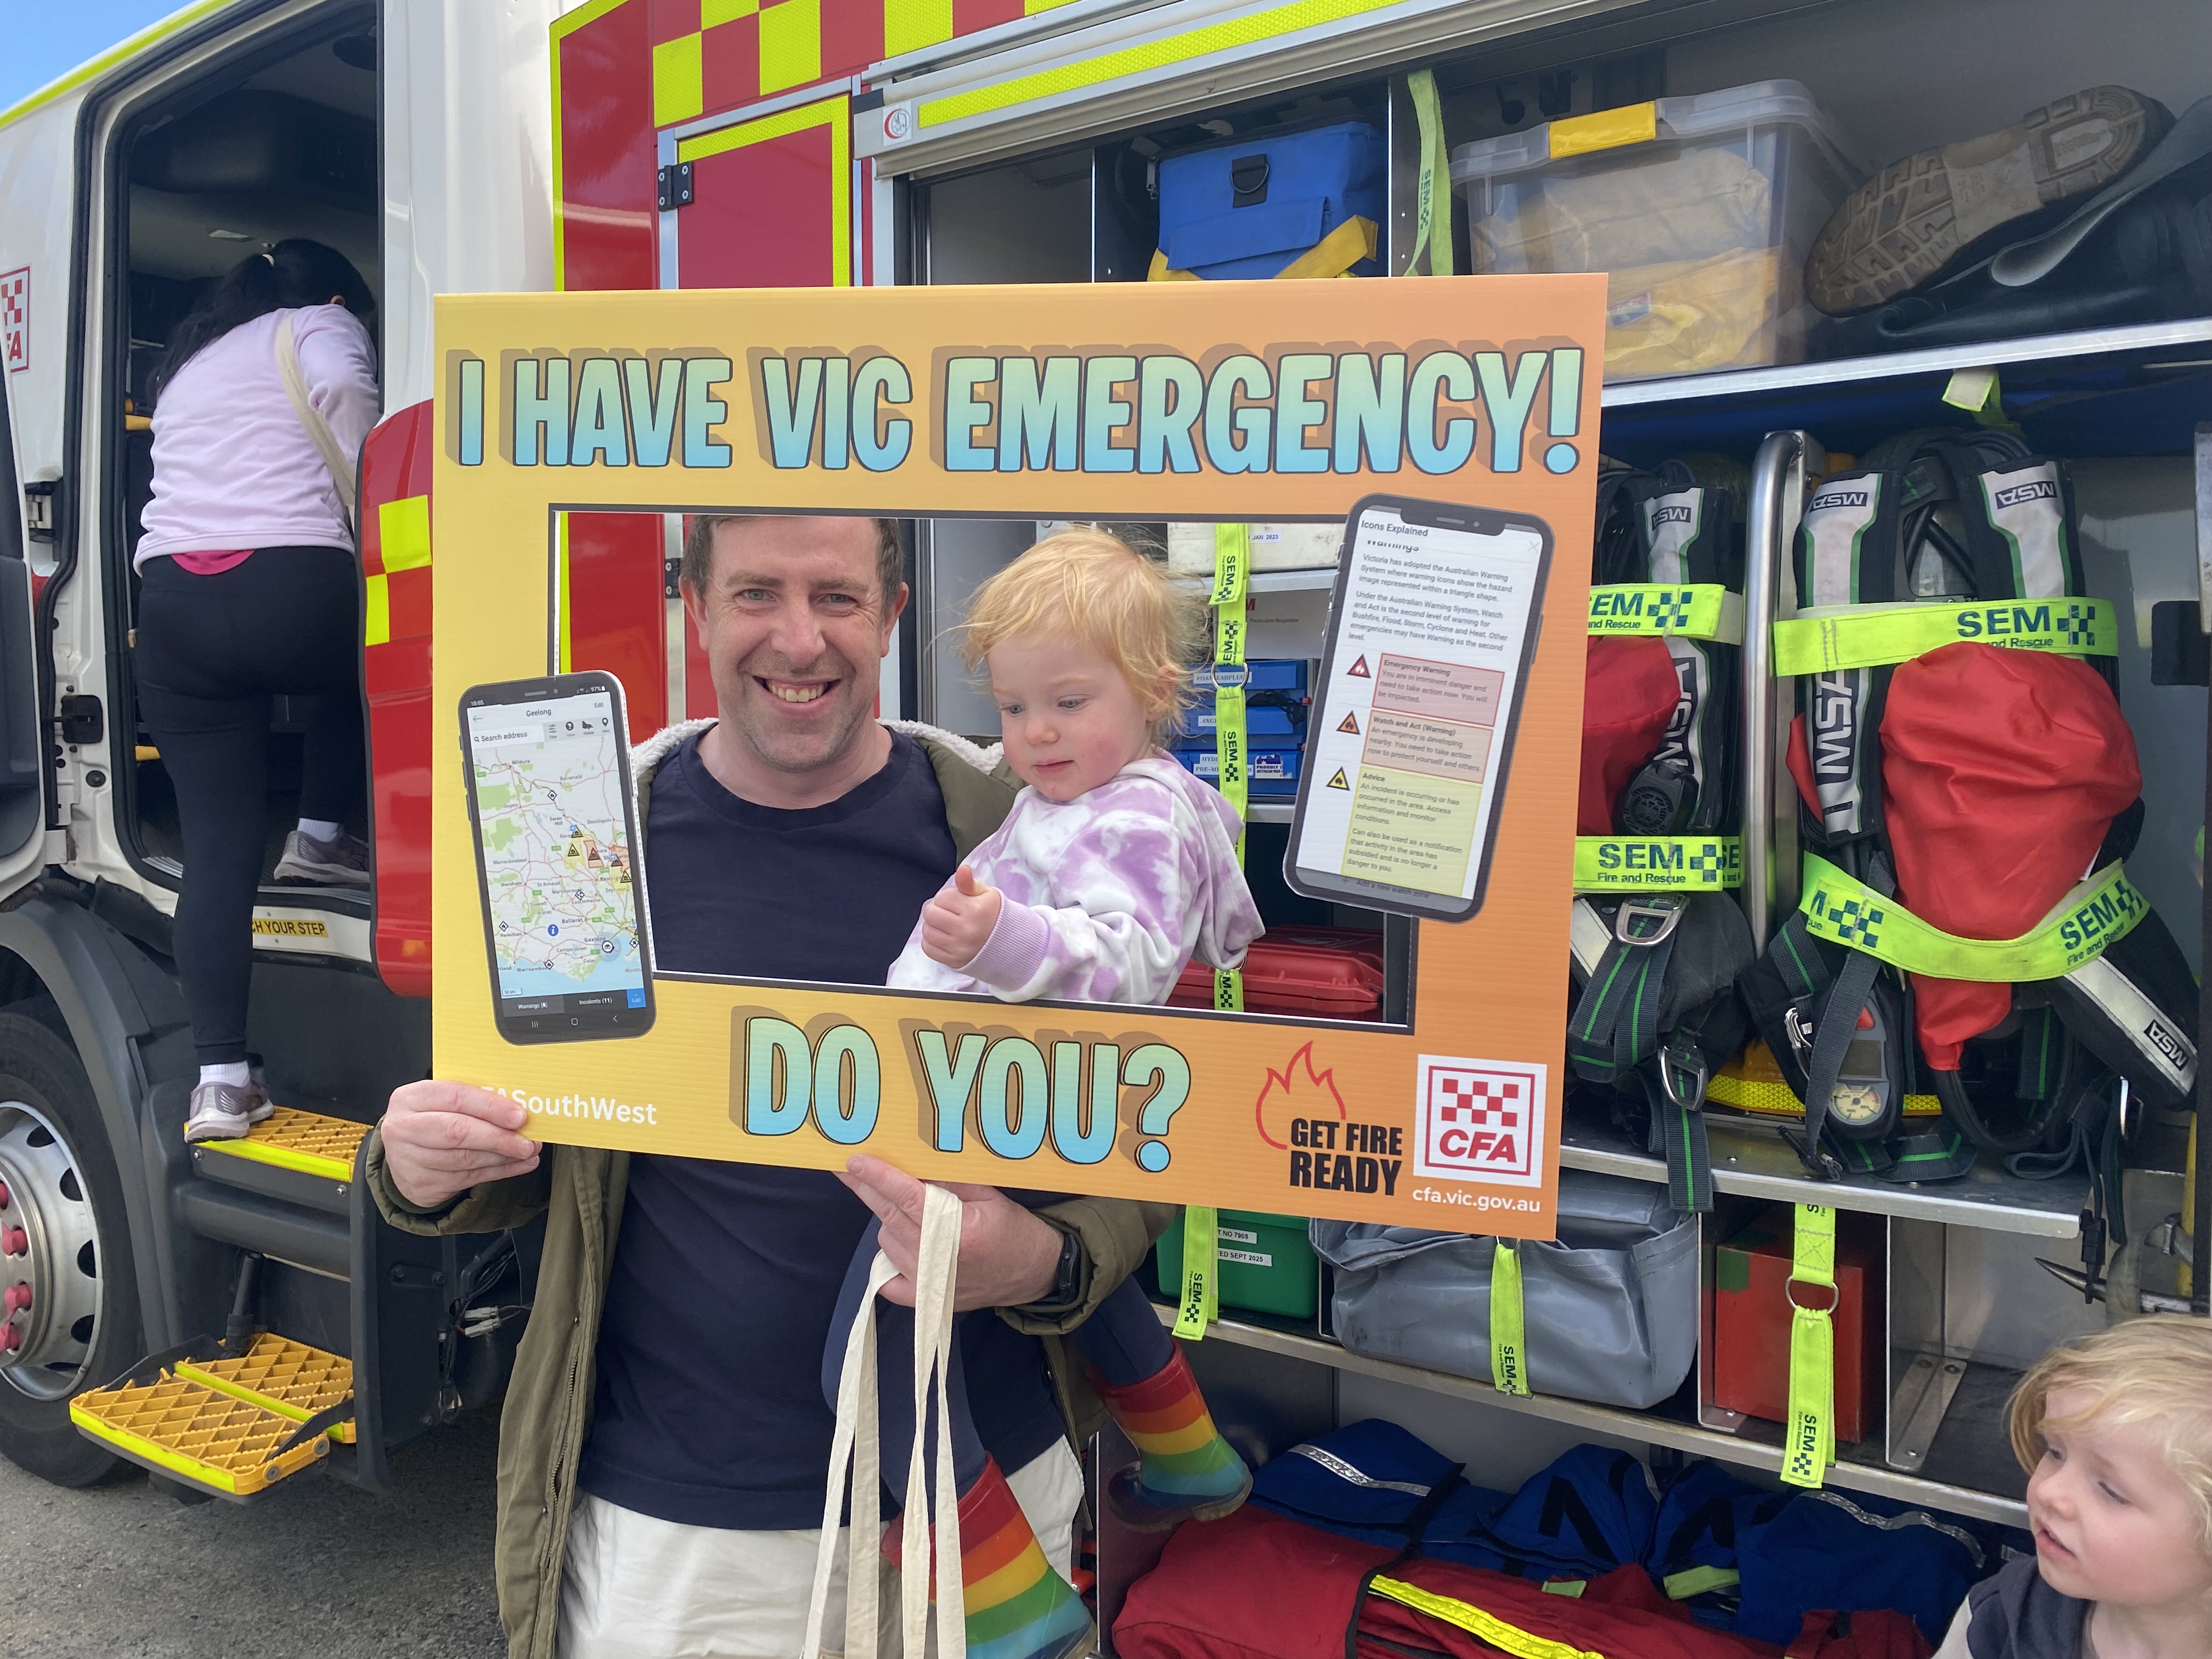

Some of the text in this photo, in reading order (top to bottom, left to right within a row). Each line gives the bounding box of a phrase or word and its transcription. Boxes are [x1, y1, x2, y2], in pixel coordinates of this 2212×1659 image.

[459, 347, 1585, 476] I HAVE VIC EMERGENCY!
[1999, 481, 2056, 507] MSA
[1361, 520, 1428, 537] Icons Explained
[1226, 555, 1235, 586] SEM
[1361, 564, 1386, 573] System
[1387, 568, 1407, 577] where
[1408, 573, 1435, 582] warning
[1436, 575, 1455, 584] icons
[1456, 578, 1475, 586] show
[1488, 583, 1513, 592] hazard
[1363, 554, 1388, 563] Victoria
[1389, 557, 1402, 566] has
[1403, 561, 1431, 569] adopted
[1444, 566, 1479, 577] Australian
[1480, 571, 1508, 582] Warning
[1359, 575, 1380, 584] image
[1380, 579, 1421, 590] represented
[1449, 589, 1475, 598] triangle
[1476, 592, 1498, 601] shape.
[1356, 590, 1376, 599] Under
[1389, 595, 1423, 606] Australian
[1424, 600, 1452, 612] Warning
[1453, 605, 1479, 616] System,
[1481, 609, 1503, 618] Watch
[1400, 609, 1425, 617] second
[1452, 617, 1479, 627] warning
[1589, 592, 1644, 616] EM
[1352, 611, 1380, 622] Bushfire,
[1381, 616, 1402, 625] Flood,
[1403, 619, 1425, 629] Storm,
[1426, 623, 1453, 633] Cyclone
[1469, 629, 1487, 637] Heat.
[1488, 632, 1508, 641] Other
[1605, 619, 1641, 629] Rescue
[1957, 606, 2051, 637] SEM
[1348, 632, 1364, 640] level.
[1350, 623, 1392, 634] emergencies
[1409, 630, 1425, 639] have
[1427, 634, 1454, 645] Warning
[1477, 642, 1503, 651] second
[2011, 637, 2053, 648] Rescue
[1383, 659, 1451, 677] Emergency Warning
[1373, 716, 1394, 725] Watch
[1422, 724, 1455, 736] (Warning)
[1227, 731, 1238, 761] SEM
[1362, 772, 1385, 782] Advice
[1598, 843, 1684, 870] SEM
[1597, 872, 1686, 883] Fire and Rescue
[264, 921, 296, 934] YOUR
[298, 922, 325, 936] STEP
[2060, 893, 2119, 950] SEM
[2067, 951, 2084, 966] Fire
[2086, 938, 2103, 955] and
[2147, 1022, 2188, 1070] MSA
[481, 1086, 657, 1125] SouthWest
[743, 1016, 1192, 1173] DO YOU?
[1290, 1118, 1403, 1156] GET FIRE
[1439, 1128, 1517, 1164] CFA
[1289, 1150, 1402, 1197] READY
[1412, 1187, 1541, 1213] cfa.vic.gov.au
[1234, 1232, 1249, 1240] 7905
[1193, 1272, 1203, 1303] SEM
[1504, 1346, 1517, 1378] SEM
[1803, 1414, 1816, 1452] SEM
